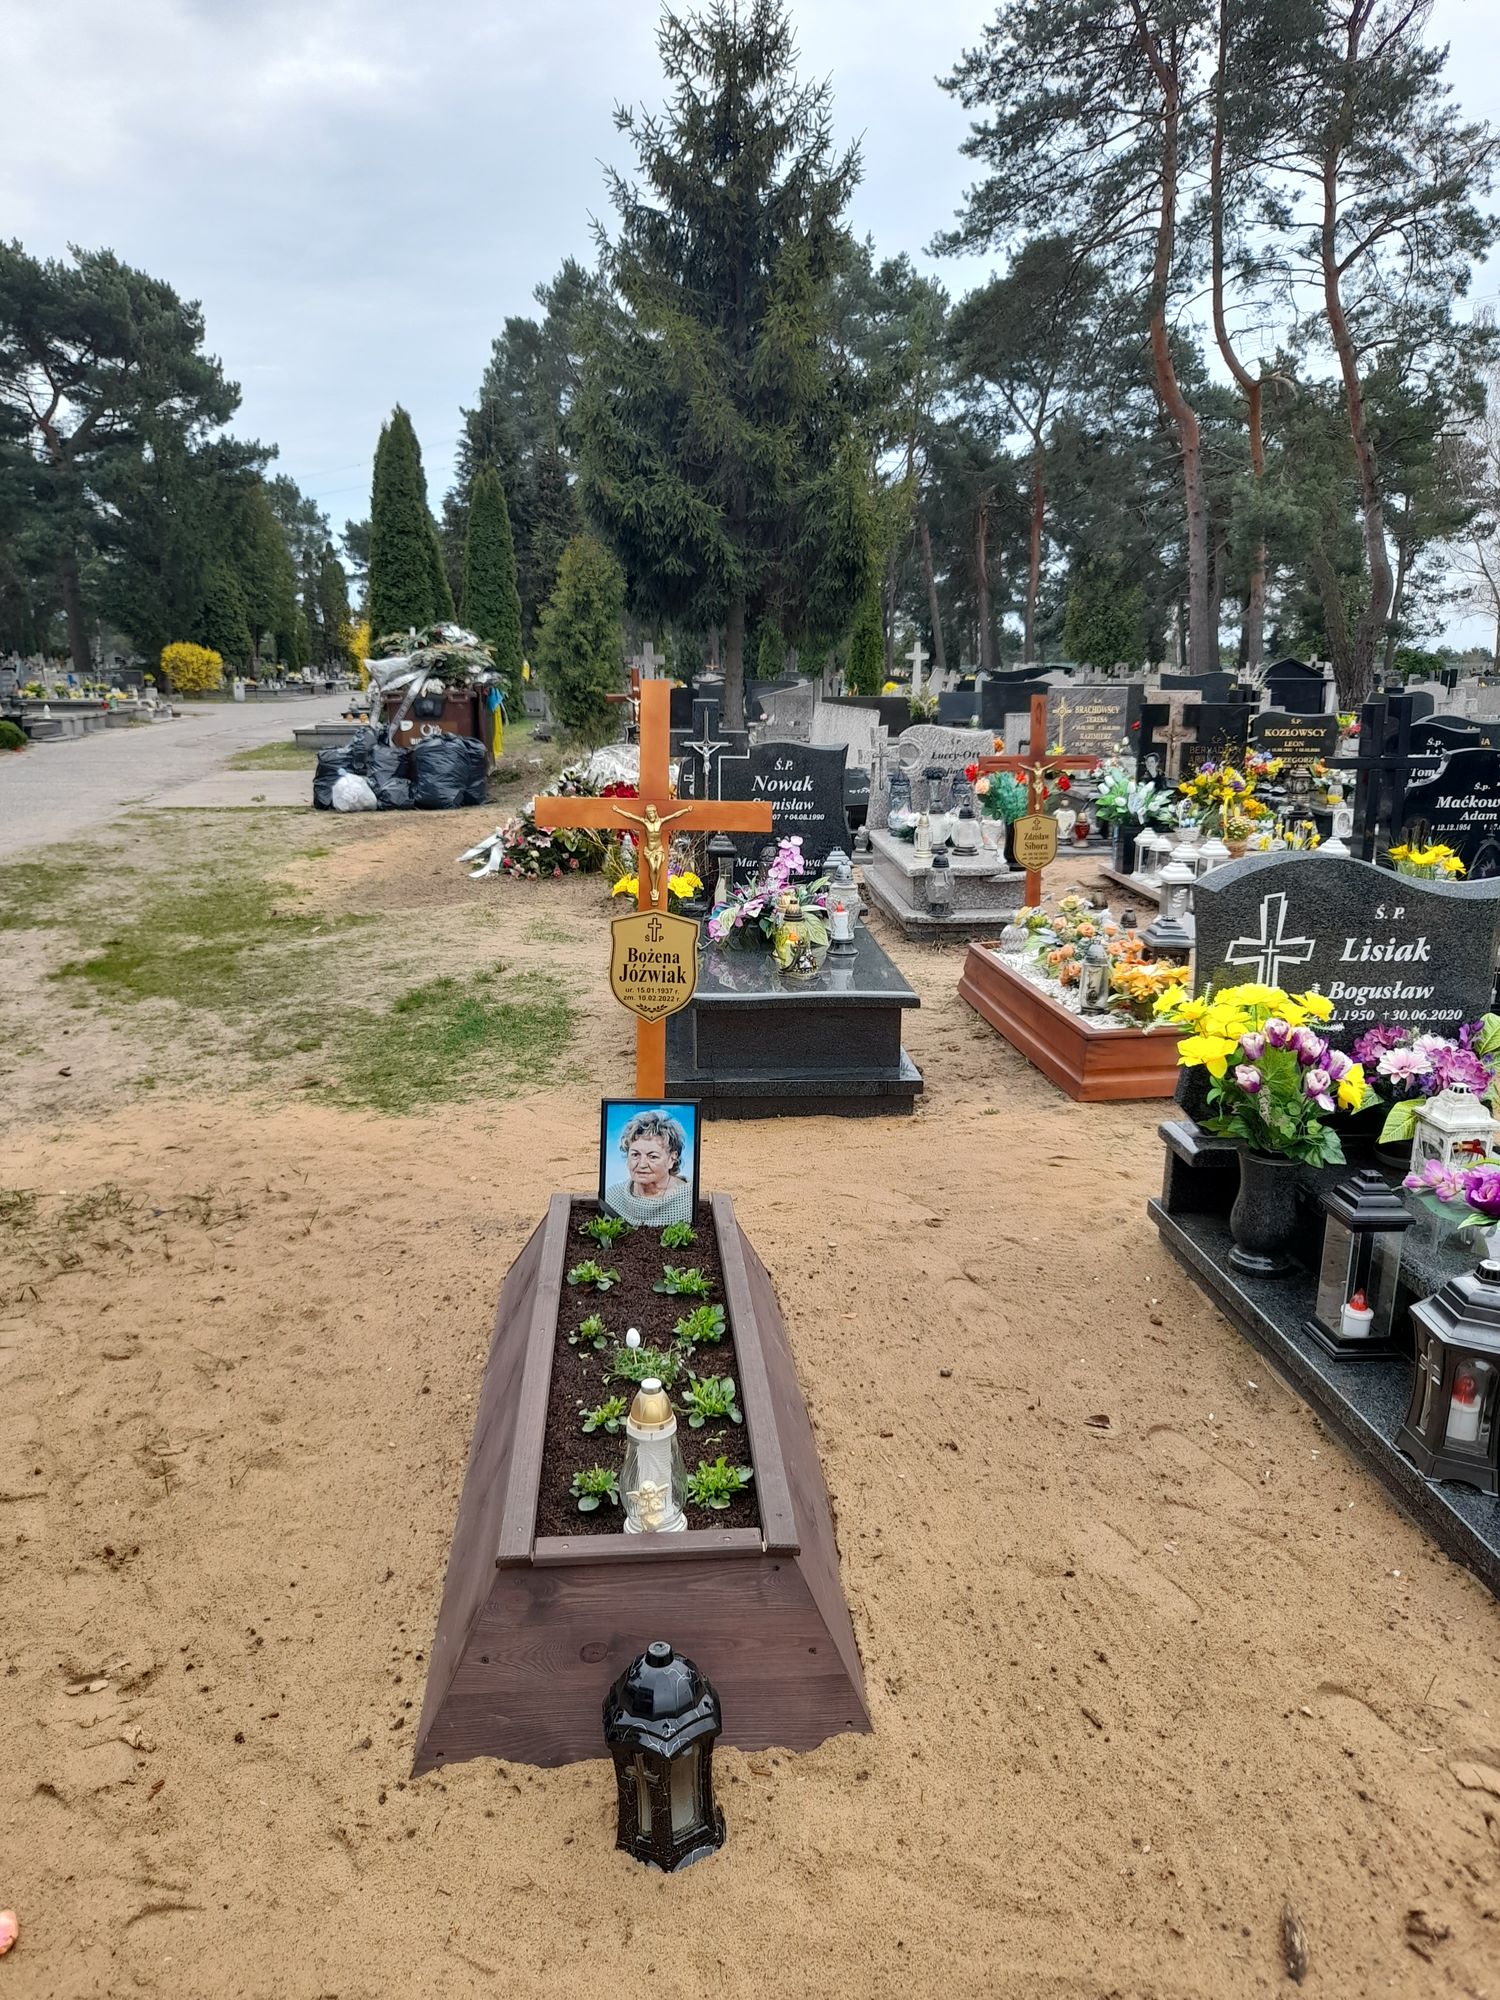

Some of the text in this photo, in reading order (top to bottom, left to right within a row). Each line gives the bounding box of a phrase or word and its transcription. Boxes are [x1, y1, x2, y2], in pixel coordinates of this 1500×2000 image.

[1264, 728, 1328, 737] KOZŁOWSCY
[774, 757, 794, 771] Ś.P.
[1410, 767, 1436, 777] Tom
[751, 775, 814, 792] Nowak
[752, 797, 814, 811] nisław
[1459, 810, 1497, 821] Adam
[628, 947, 680, 964] Bożena
[1339, 937, 1431, 962] Lisiak
[619, 963, 687, 984] Jóźwiak
[1329, 981, 1435, 1005] Bogusław
